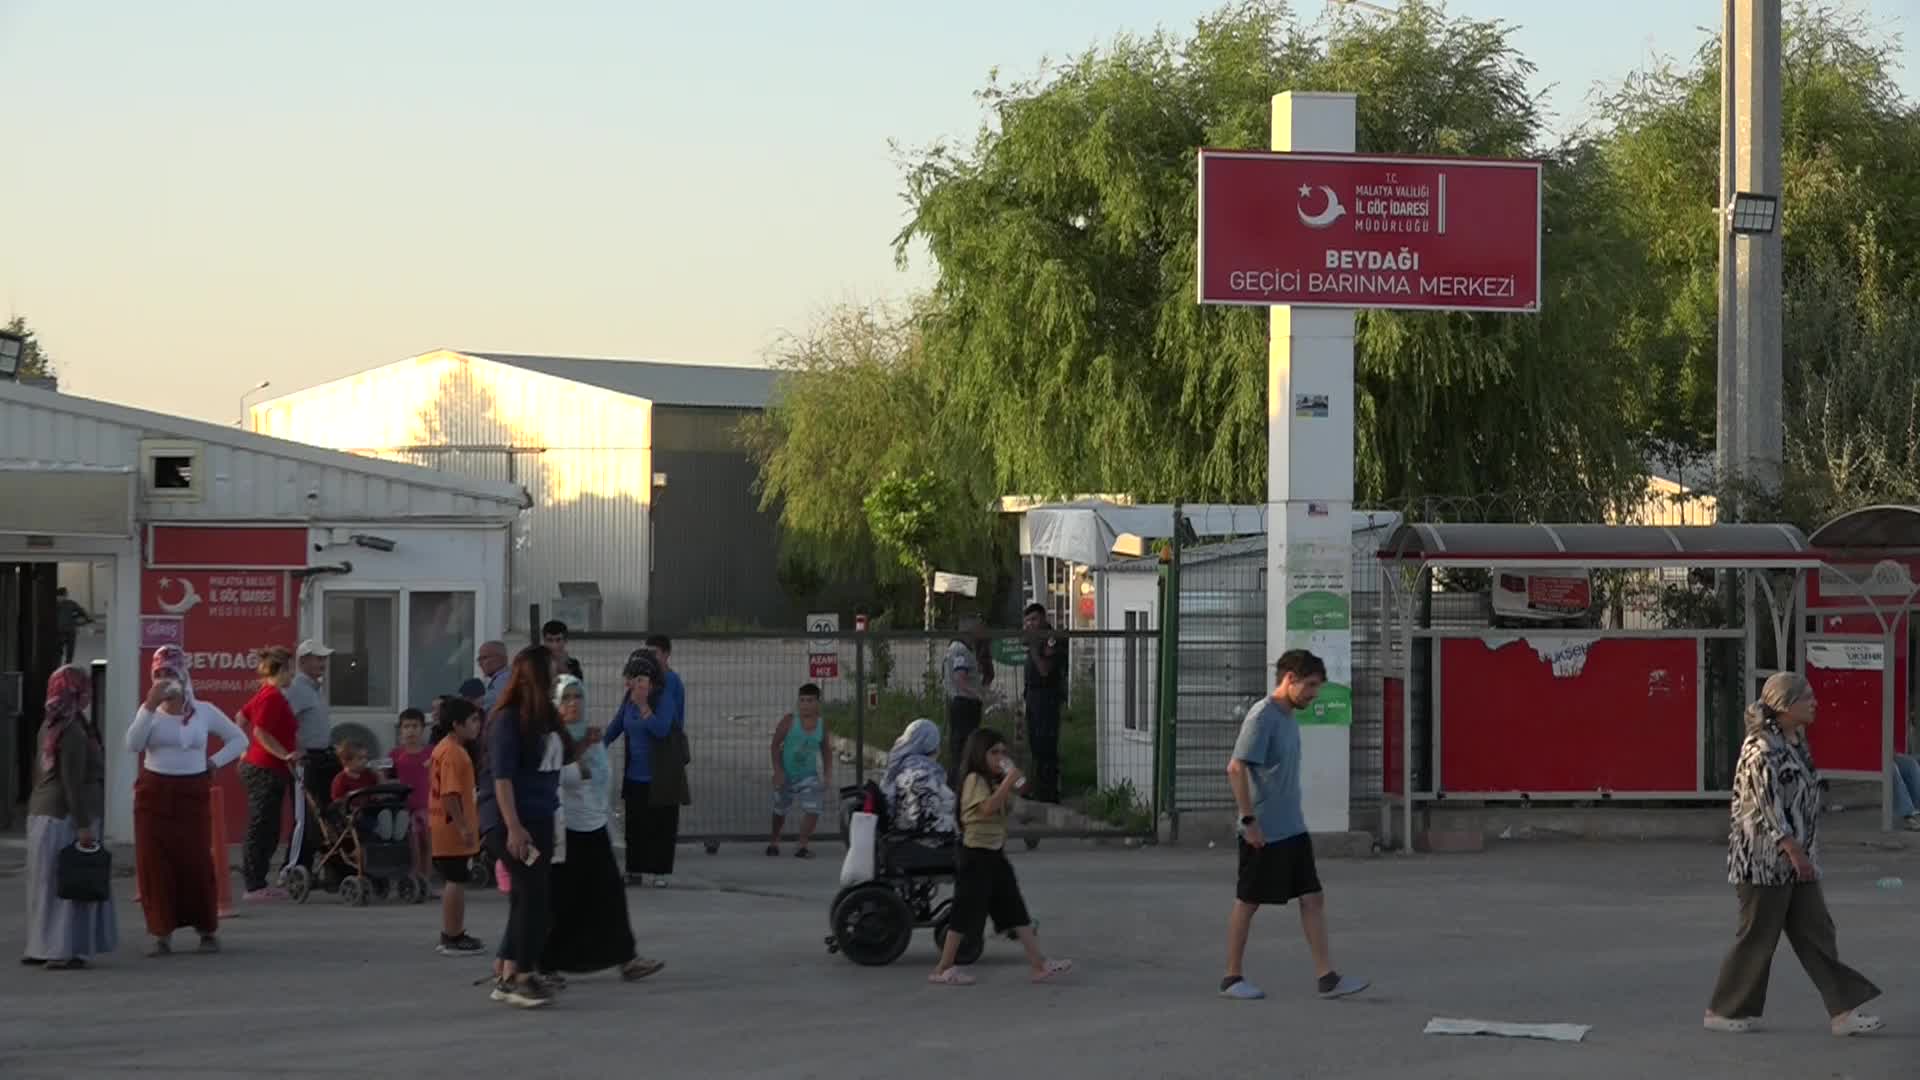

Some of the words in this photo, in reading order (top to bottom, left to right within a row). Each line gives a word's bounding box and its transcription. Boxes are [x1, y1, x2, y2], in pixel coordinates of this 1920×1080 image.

[1356, 185, 1393, 197] MALATYA
[1396, 184, 1430, 198] VALİLİĞİ
[1355, 197, 1365, 214] İL
[1367, 197, 1388, 219] GÖÇ
[1390, 198, 1429, 217] İDARESİ
[1355, 217, 1429, 233] MÜDÜRLÜĞÜ
[1325, 246, 1419, 271] BEYDAĞI
[1230, 267, 1300, 296] GEÇİCİ
[1308, 272, 1411, 295] BARINMA
[1420, 274, 1515, 297] MERKEZİ
[184, 648, 259, 670] BEYDAĞ
